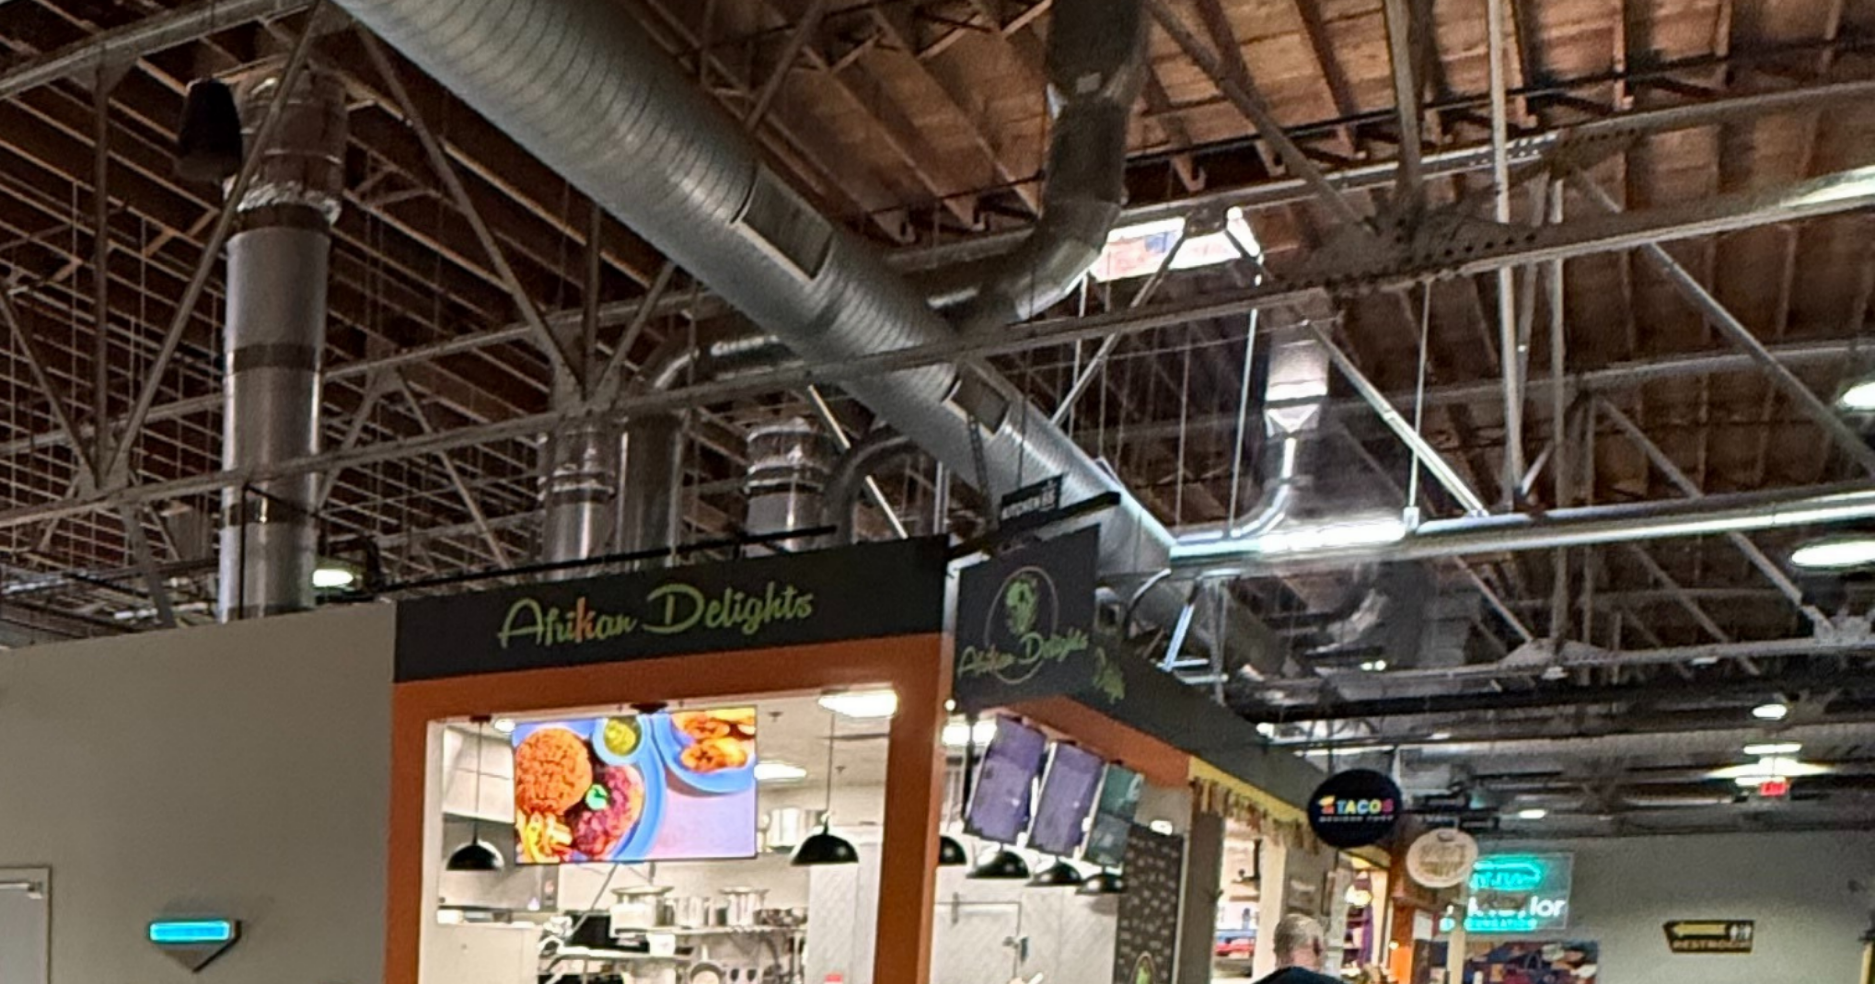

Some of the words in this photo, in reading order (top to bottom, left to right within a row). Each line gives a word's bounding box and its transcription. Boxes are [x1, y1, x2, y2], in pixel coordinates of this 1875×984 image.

[497, 596, 637, 648] Afrikan
[642, 581, 814, 635] Delights
[1337, 799, 1394, 814] TACOS
